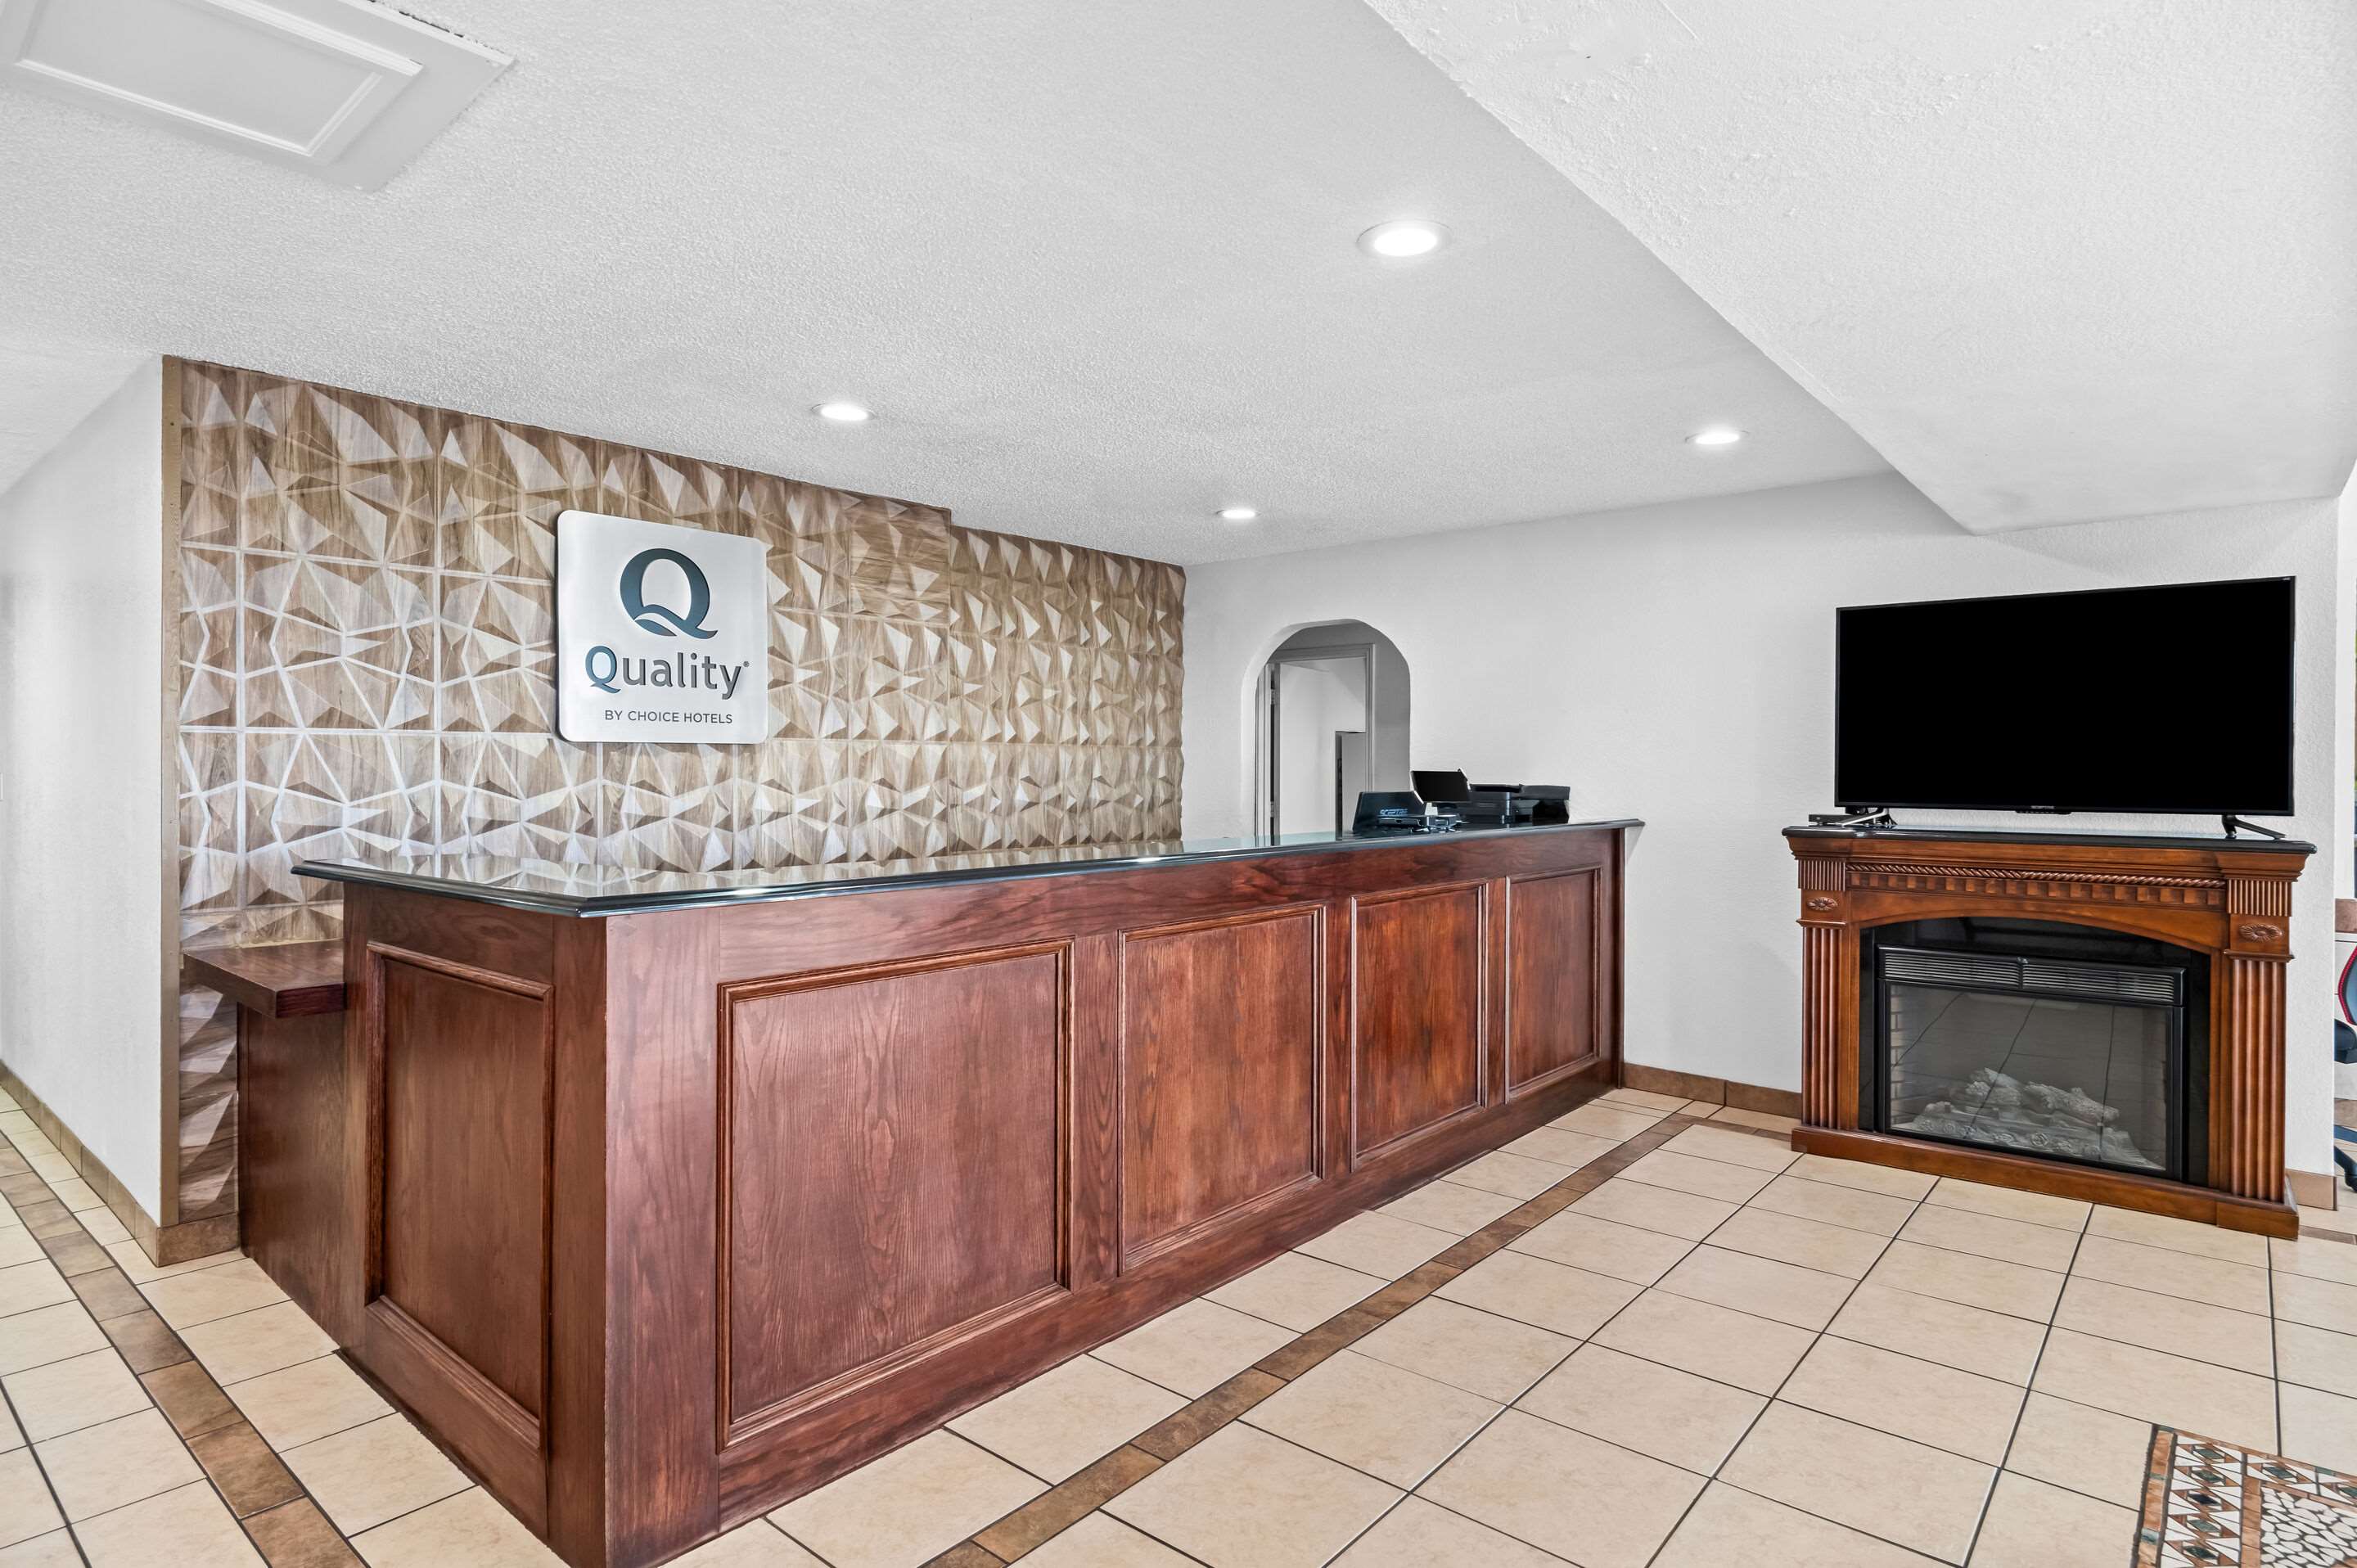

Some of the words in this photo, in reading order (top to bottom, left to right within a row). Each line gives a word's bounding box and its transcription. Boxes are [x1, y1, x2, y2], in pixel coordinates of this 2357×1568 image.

[620, 547, 719, 639] Q
[605, 710, 623, 720] BY
[628, 710, 679, 722] CHOICE
[683, 713, 733, 724] HOTELS
